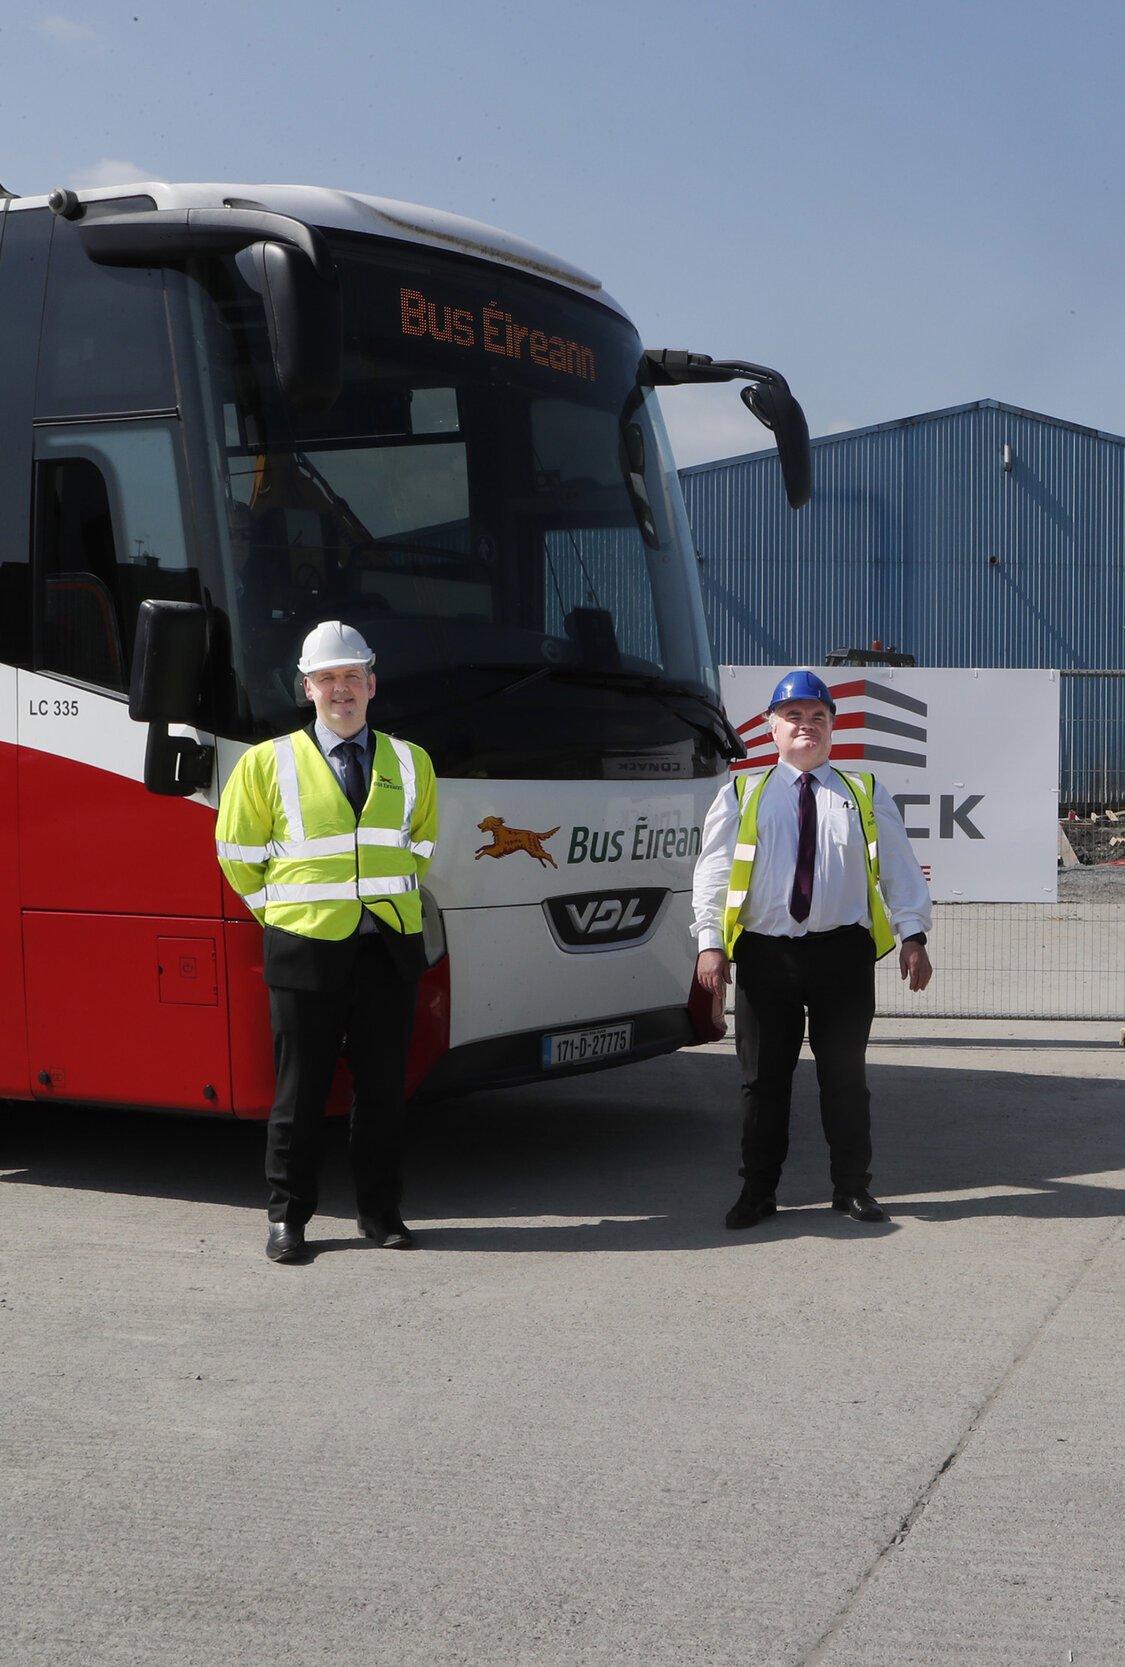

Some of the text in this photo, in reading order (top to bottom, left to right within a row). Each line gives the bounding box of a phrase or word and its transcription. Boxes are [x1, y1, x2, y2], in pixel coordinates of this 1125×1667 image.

[400, 287, 596, 382] Bus Éireann
[29, 699, 79, 717] LC 335
[567, 826, 625, 865] Bus
[631, 816, 703, 861] Éirean
[564, 898, 646, 935] VDL
[557, 1030, 628, 1063] 171-D-27775
